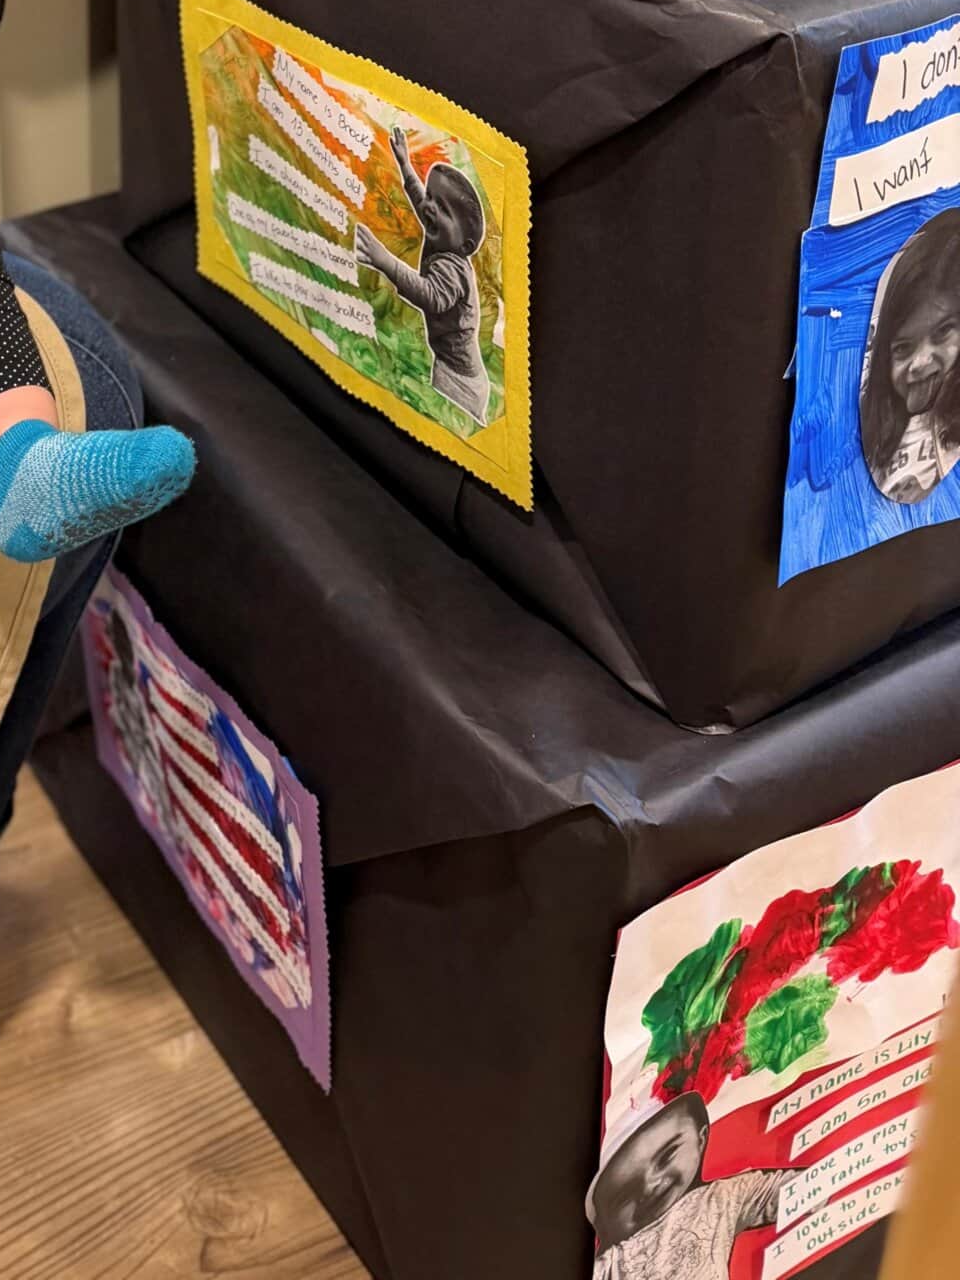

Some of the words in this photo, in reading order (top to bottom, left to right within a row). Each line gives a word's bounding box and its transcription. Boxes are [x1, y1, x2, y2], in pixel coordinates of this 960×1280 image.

[277, 54, 295, 84] My
[297, 80, 318, 105] name
[921, 36, 960, 90] don
[261, 87, 273, 104] I
[271, 102, 284, 119] am
[306, 137, 340, 177] months
[345, 178, 361, 194] old
[873, 136, 933, 201] want
[809, 1062, 863, 1100] name
[874, 1053, 891, 1065] is
[898, 1030, 932, 1055] Lily
[798, 1128, 813, 1149] I
[820, 1111, 848, 1136] am
[902, 1062, 934, 1087] old
[785, 1186, 797, 1200] I
[805, 1157, 837, 1183] love
[845, 1142, 864, 1157] to
[785, 1186, 822, 1216] with
[831, 1154, 874, 1185] rattle
[883, 1129, 918, 1154] toys
[772, 1241, 785, 1258] I
[796, 1212, 831, 1240] love
[841, 1199, 857, 1212] to
